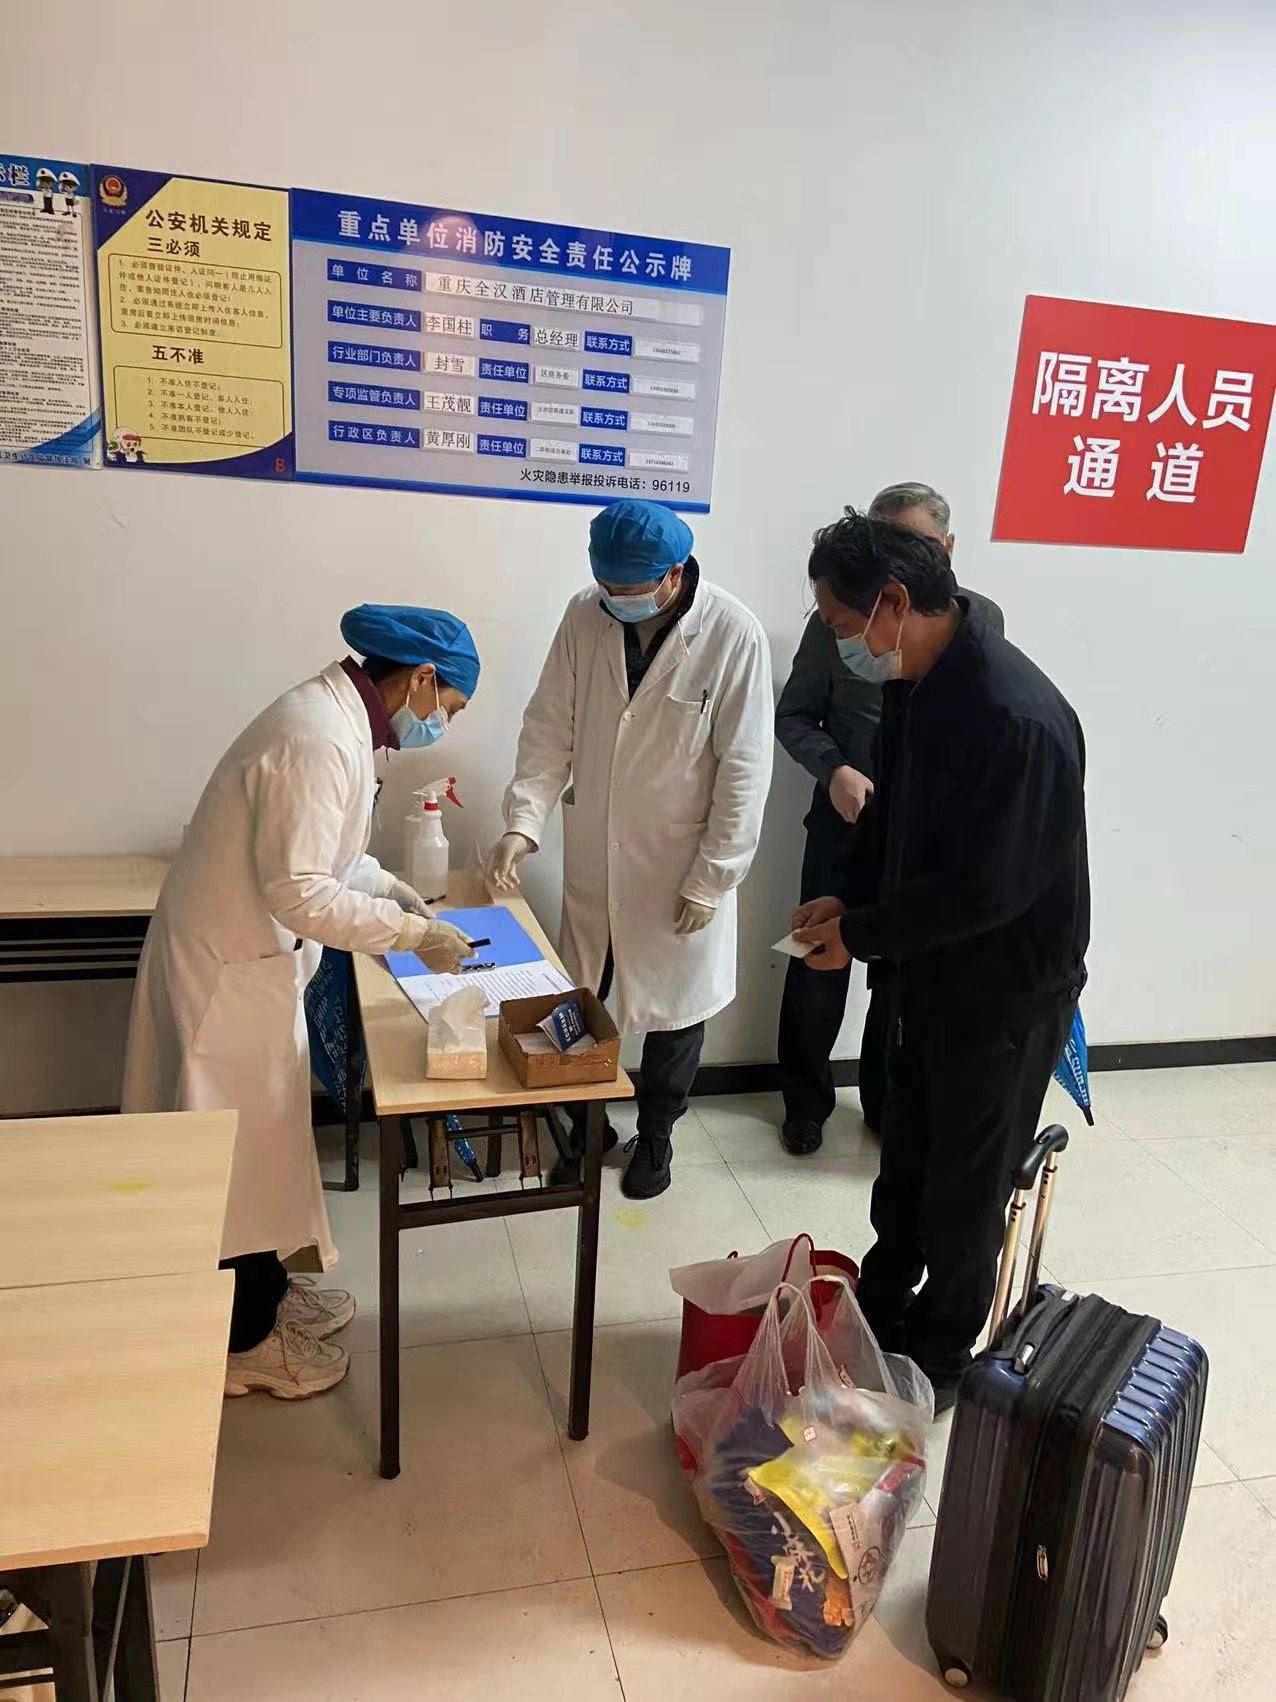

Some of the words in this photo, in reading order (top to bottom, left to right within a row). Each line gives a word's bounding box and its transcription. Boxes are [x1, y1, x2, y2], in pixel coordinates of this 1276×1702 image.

[0, 161, 30, 187] 栏
[145, 209, 272, 241] 公安机关规定
[147, 238, 201, 258] 三必须
[338, 210, 692, 282] 重点单位消防安全责任公示牌
[331, 263, 419, 287] 单位名称
[437, 276, 634, 315] 重庆全汉酒店管理有限公司
[331, 304, 417, 328] 单位主要负责人
[425, 314, 473, 335] 李国柱
[481, 321, 530, 341] 职务
[534, 328, 580, 348] 总经理
[586, 335, 631, 353] 联系方式
[152, 344, 205, 365] 五不准
[332, 346, 417, 368] 行业部门负责人
[434, 354, 465, 374] 封雪
[480, 362, 528, 380] 责任单位
[584, 373, 628, 390] 联系方式
[1031, 350, 1255, 432] 隔离人员
[332, 386, 417, 406] 专项监管负责人
[425, 393, 472, 413] 王茂靓
[480, 400, 526, 418] 责任单位
[582, 411, 626, 427] 联系方式
[333, 425, 416, 445] 行政区负责人
[426, 431, 471, 450] 黄厚刚
[479, 439, 525, 456] 责任单位
[580, 447, 624, 463] 联系方式
[1063, 434, 1205, 503] 通道
